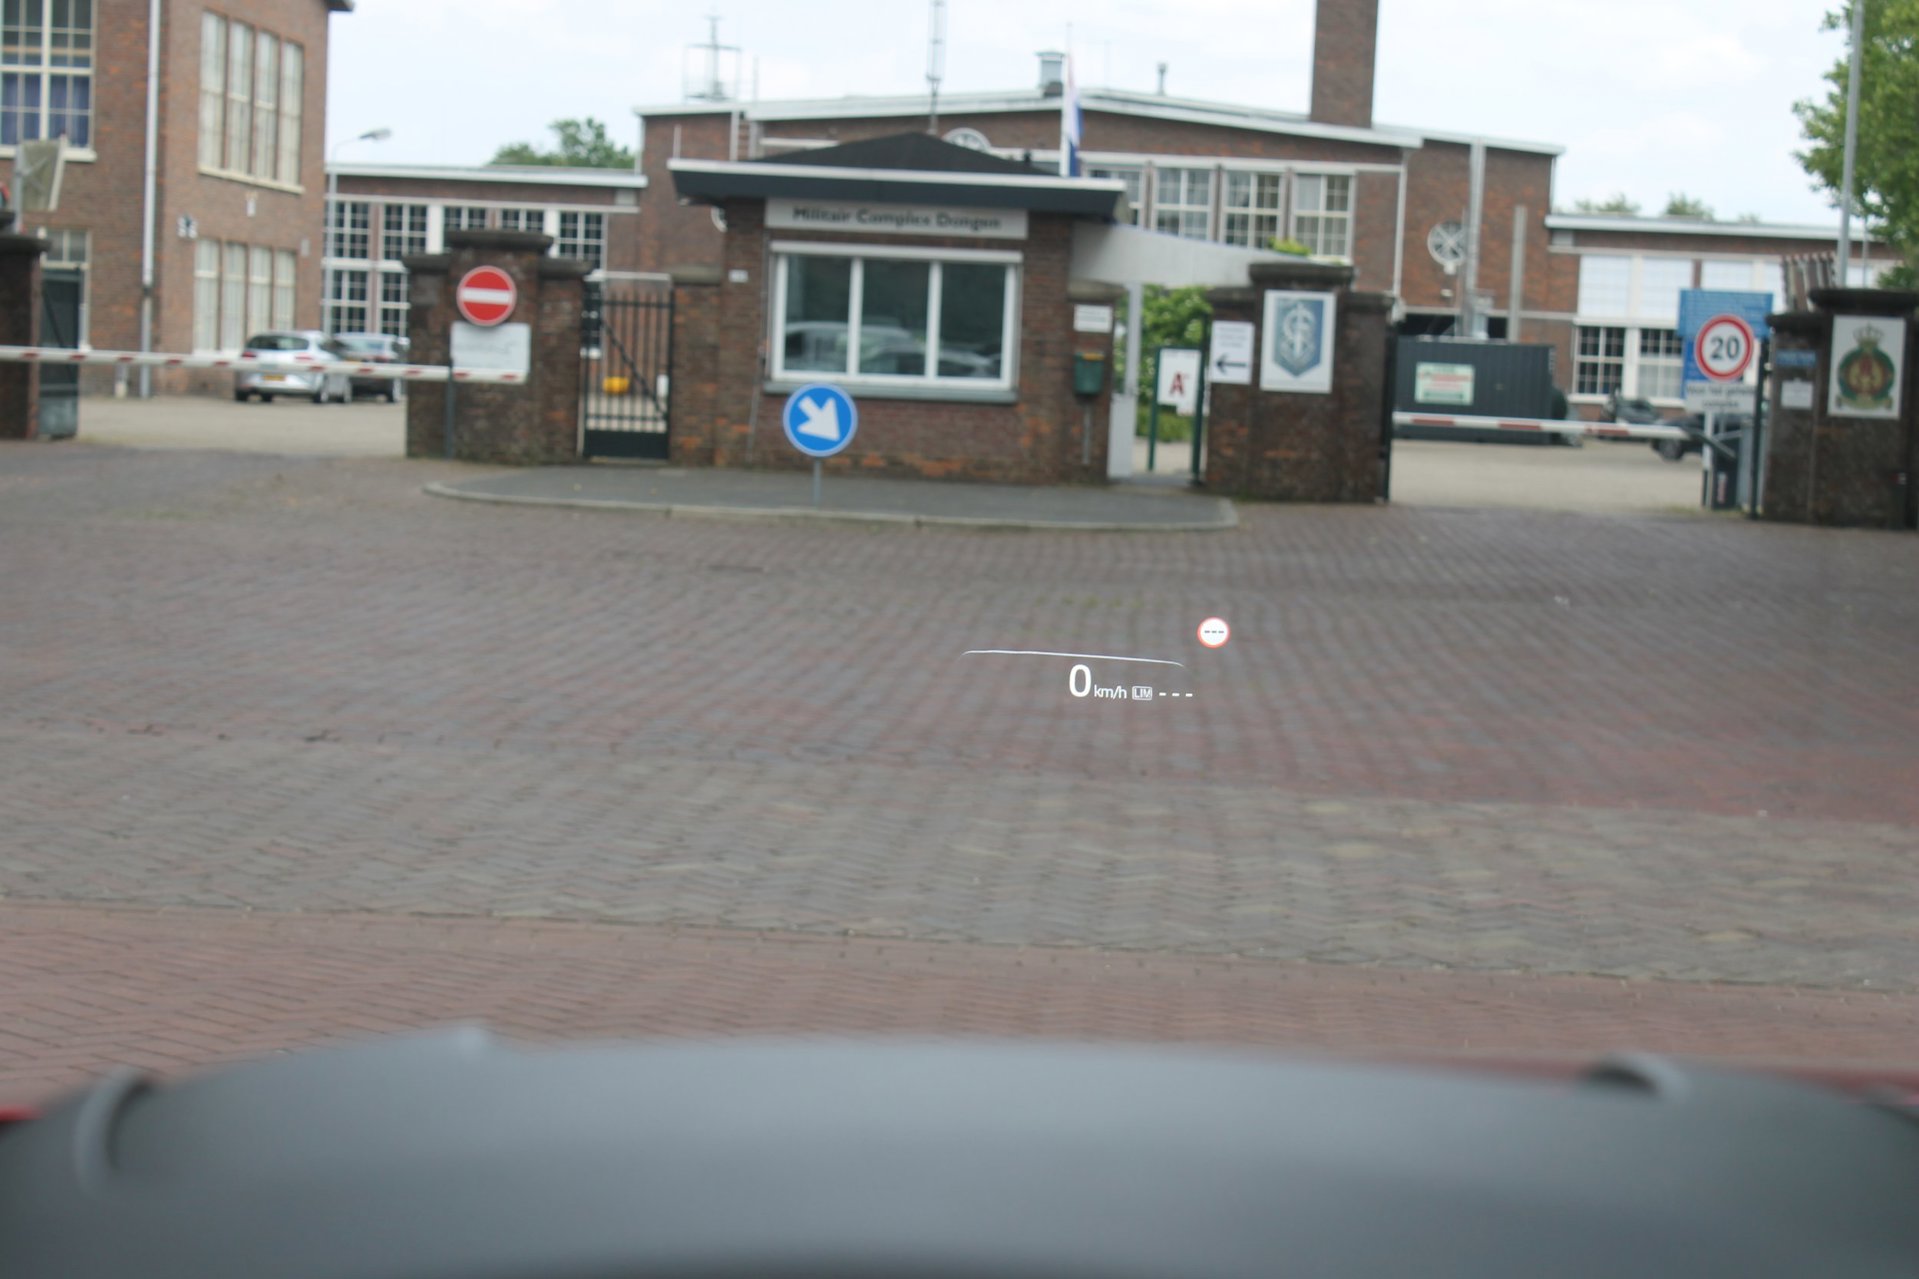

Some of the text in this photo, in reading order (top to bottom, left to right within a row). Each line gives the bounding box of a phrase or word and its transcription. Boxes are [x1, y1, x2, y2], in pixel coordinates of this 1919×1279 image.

[1711, 335, 1740, 360] 20
[1169, 371, 1185, 397] A
[1069, 664, 1152, 699] 0 km/h LIM
